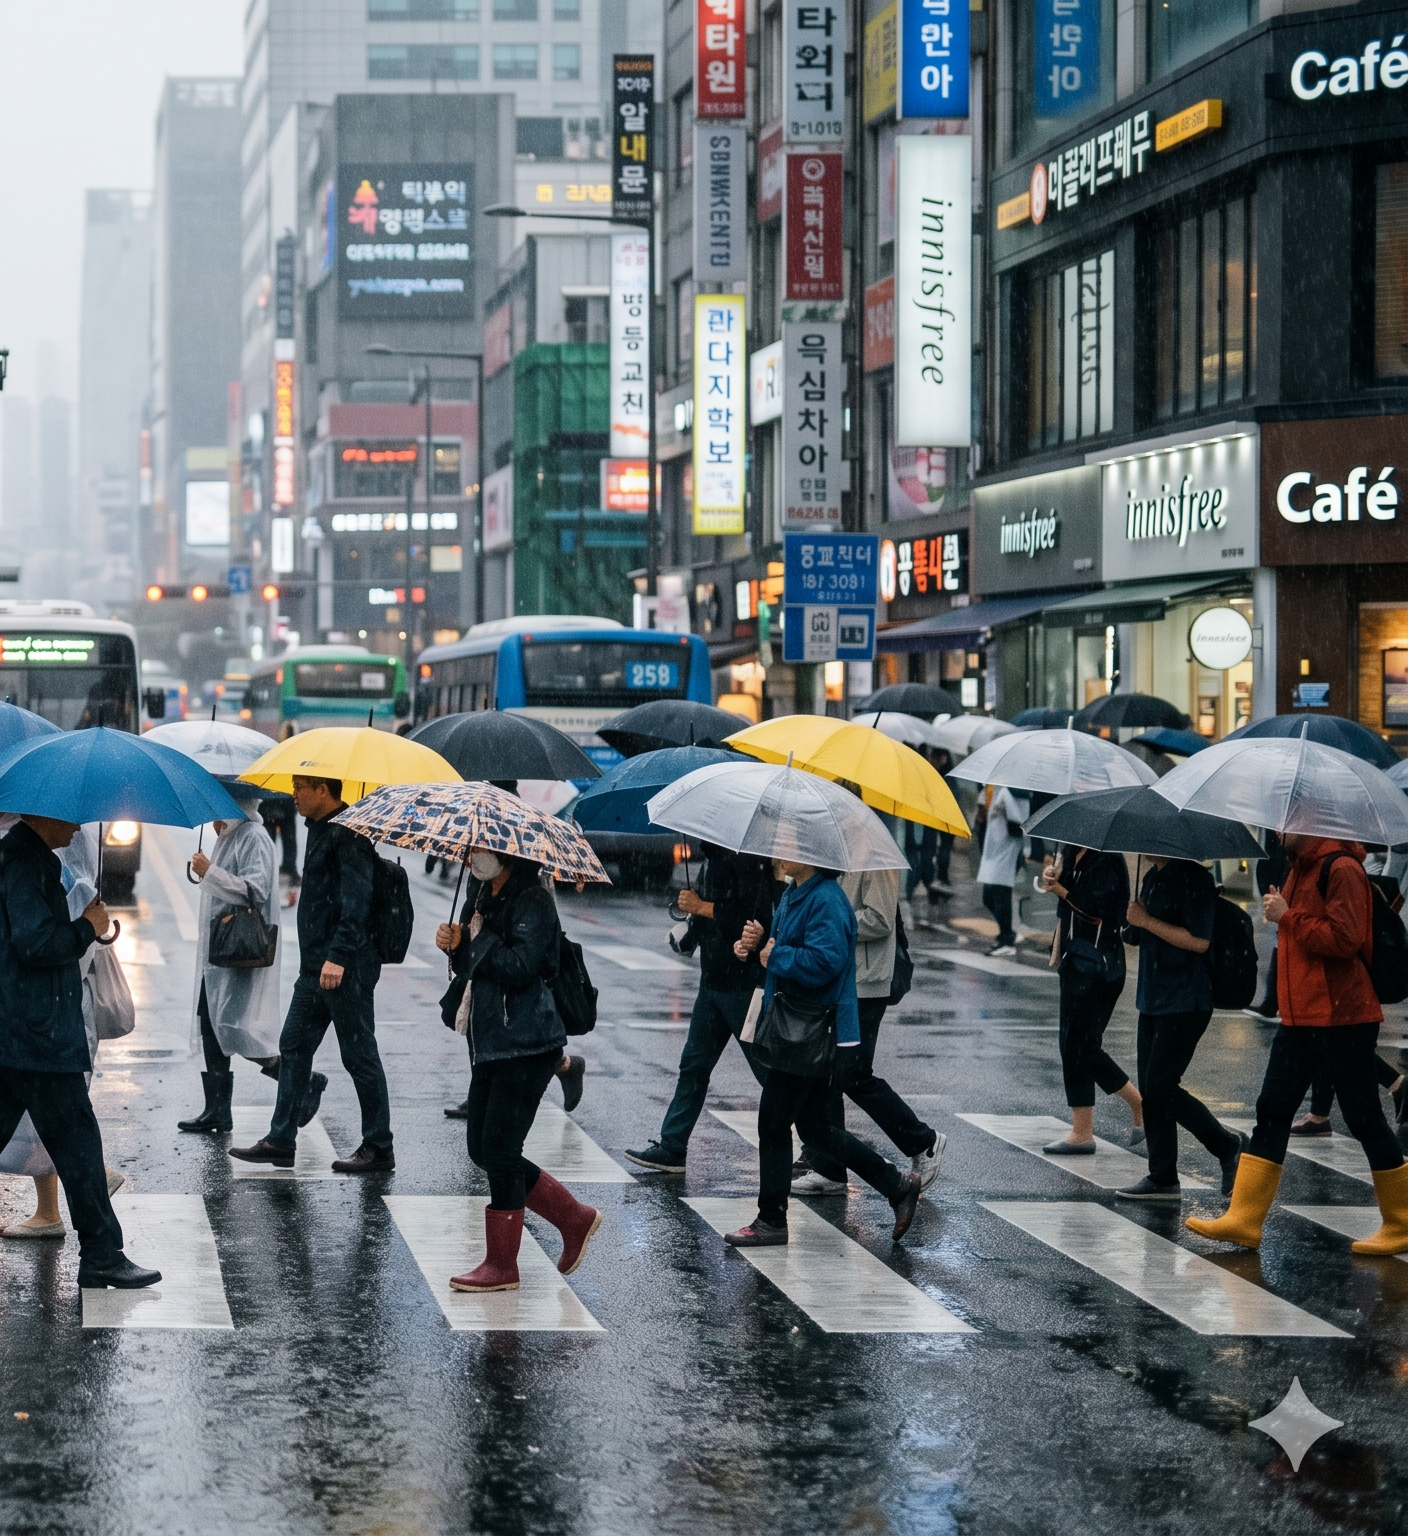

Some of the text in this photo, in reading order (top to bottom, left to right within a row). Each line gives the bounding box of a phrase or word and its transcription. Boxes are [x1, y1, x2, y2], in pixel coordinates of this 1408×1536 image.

[1291, 34, 1408, 100] Café
[912, 197, 955, 385] innisfree
[1126, 474, 1228, 547] innisfree
[1277, 467, 1398, 523] Café
[633, 663, 670, 686] 258
